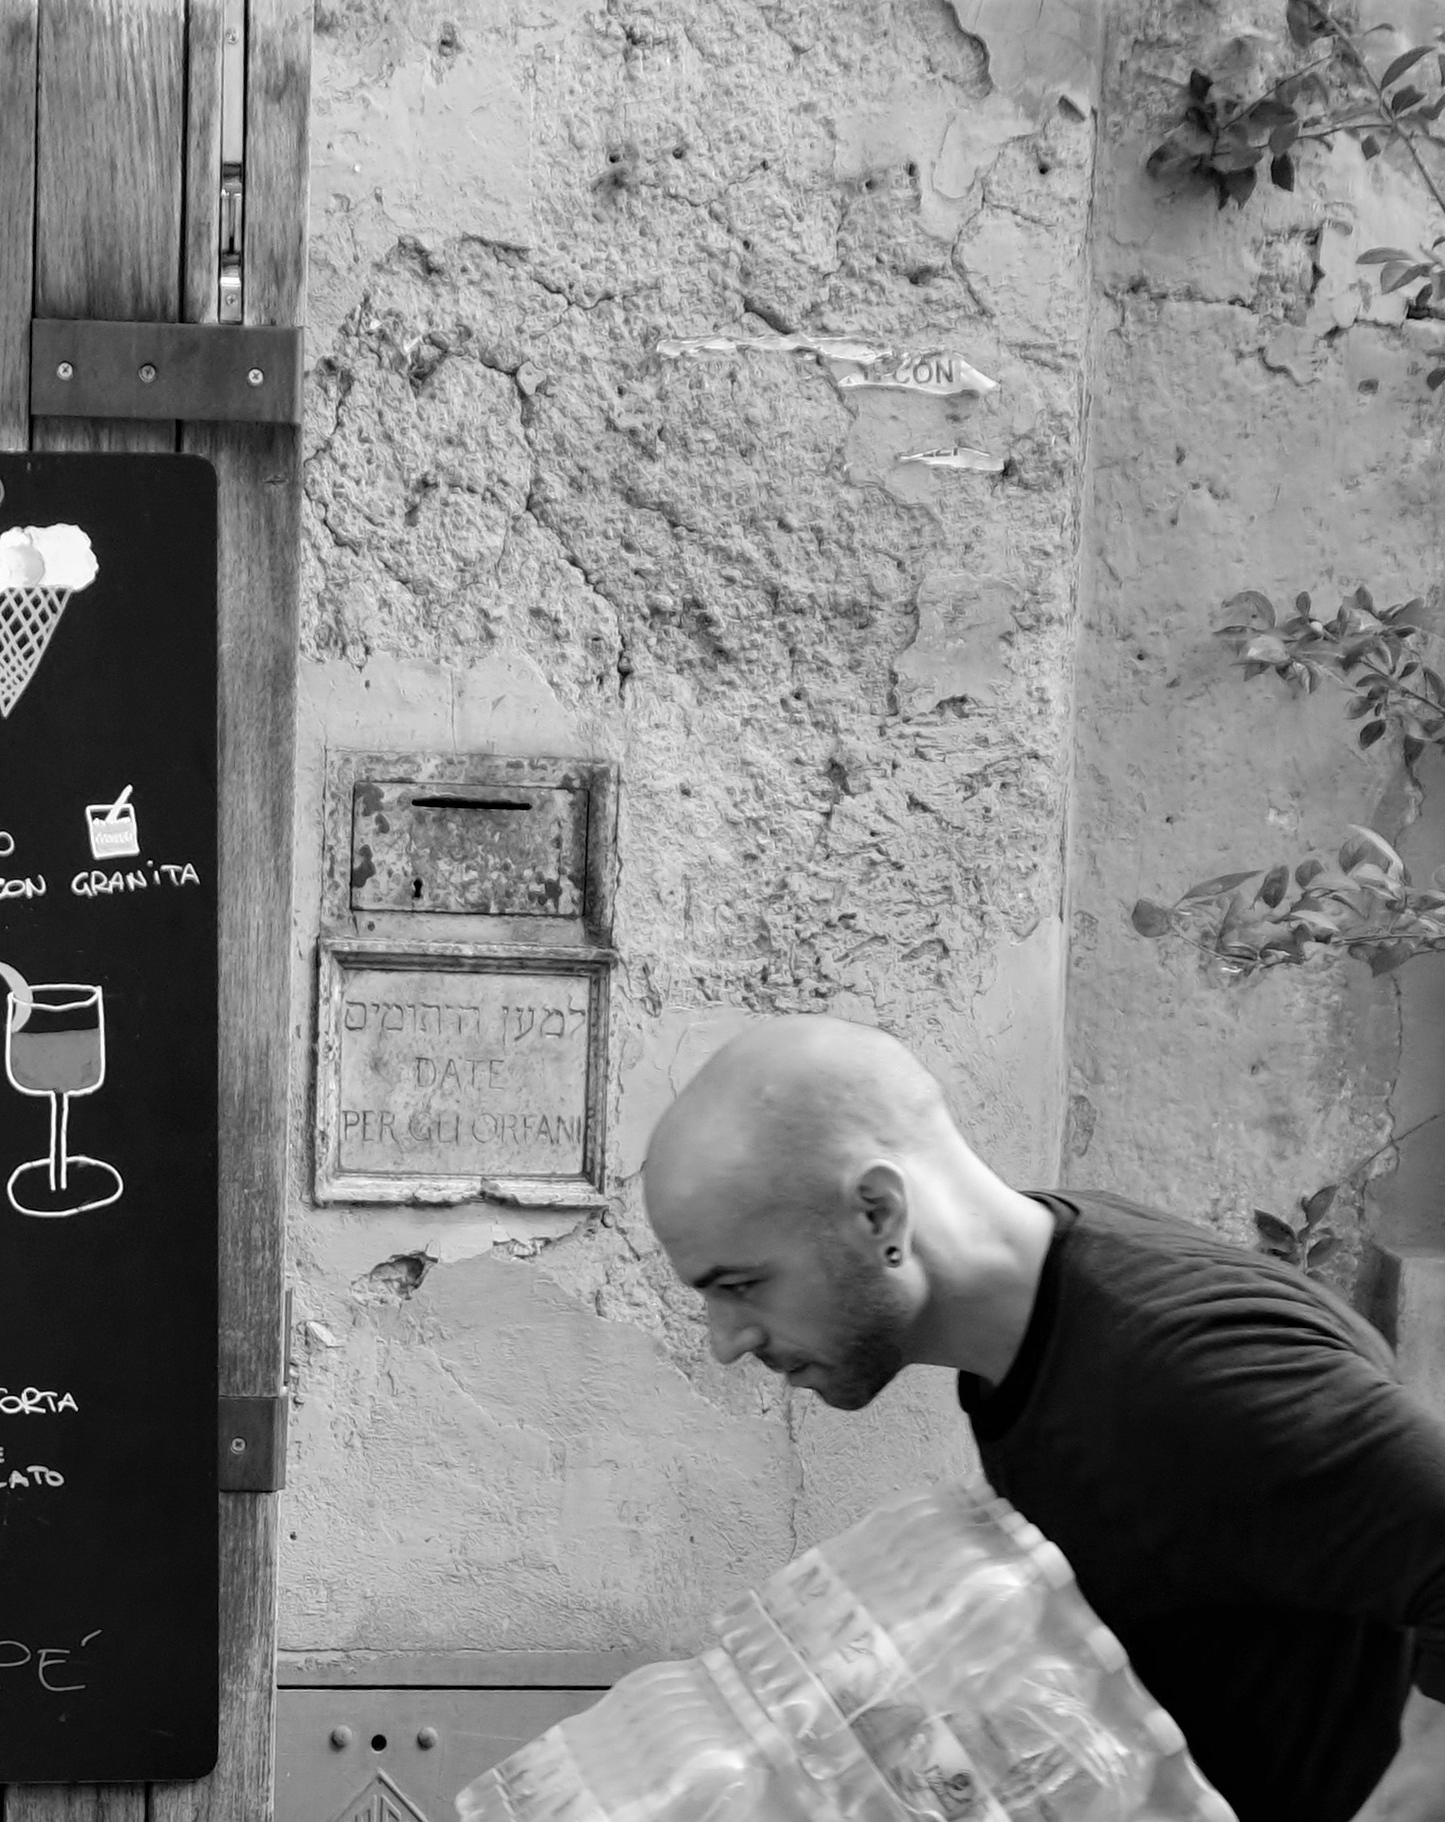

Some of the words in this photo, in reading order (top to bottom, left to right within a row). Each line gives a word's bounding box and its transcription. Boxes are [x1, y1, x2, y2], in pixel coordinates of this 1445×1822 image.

[70, 859, 202, 899] GRANITA
[500, 1000, 588, 1052] למען
[415, 1056, 506, 1092] DATE
[342, 1109, 399, 1145] PER
[408, 1111, 460, 1145] GLI
[471, 1110, 584, 1146] ORFANI
